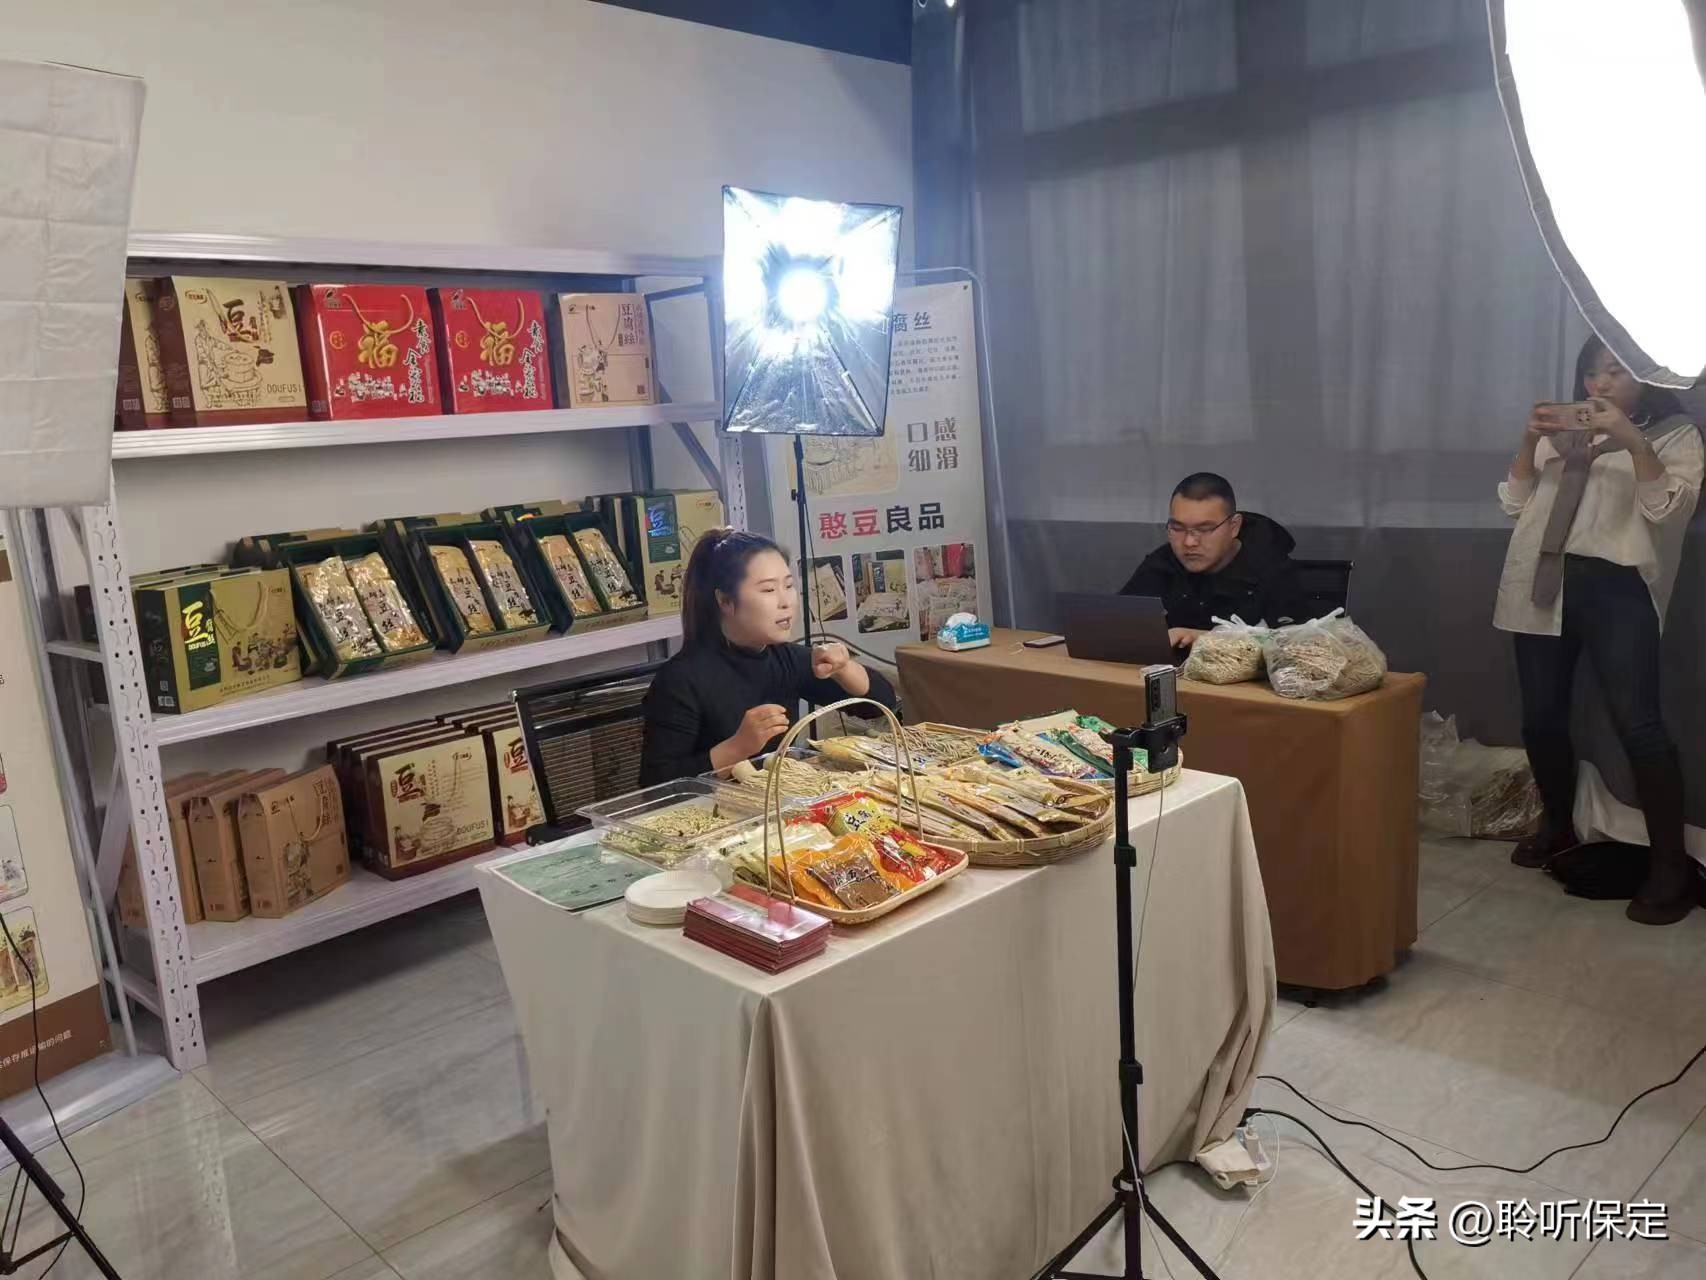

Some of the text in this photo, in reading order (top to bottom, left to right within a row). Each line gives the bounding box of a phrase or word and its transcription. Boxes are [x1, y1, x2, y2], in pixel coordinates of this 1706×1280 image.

[358, 320, 399, 369] 福
[480, 321, 516, 367] 福
[907, 417, 957, 443] 口感
[908, 446, 959, 472] 细滑
[818, 502, 945, 539] 憨豆良品
[182, 600, 210, 644] 豆
